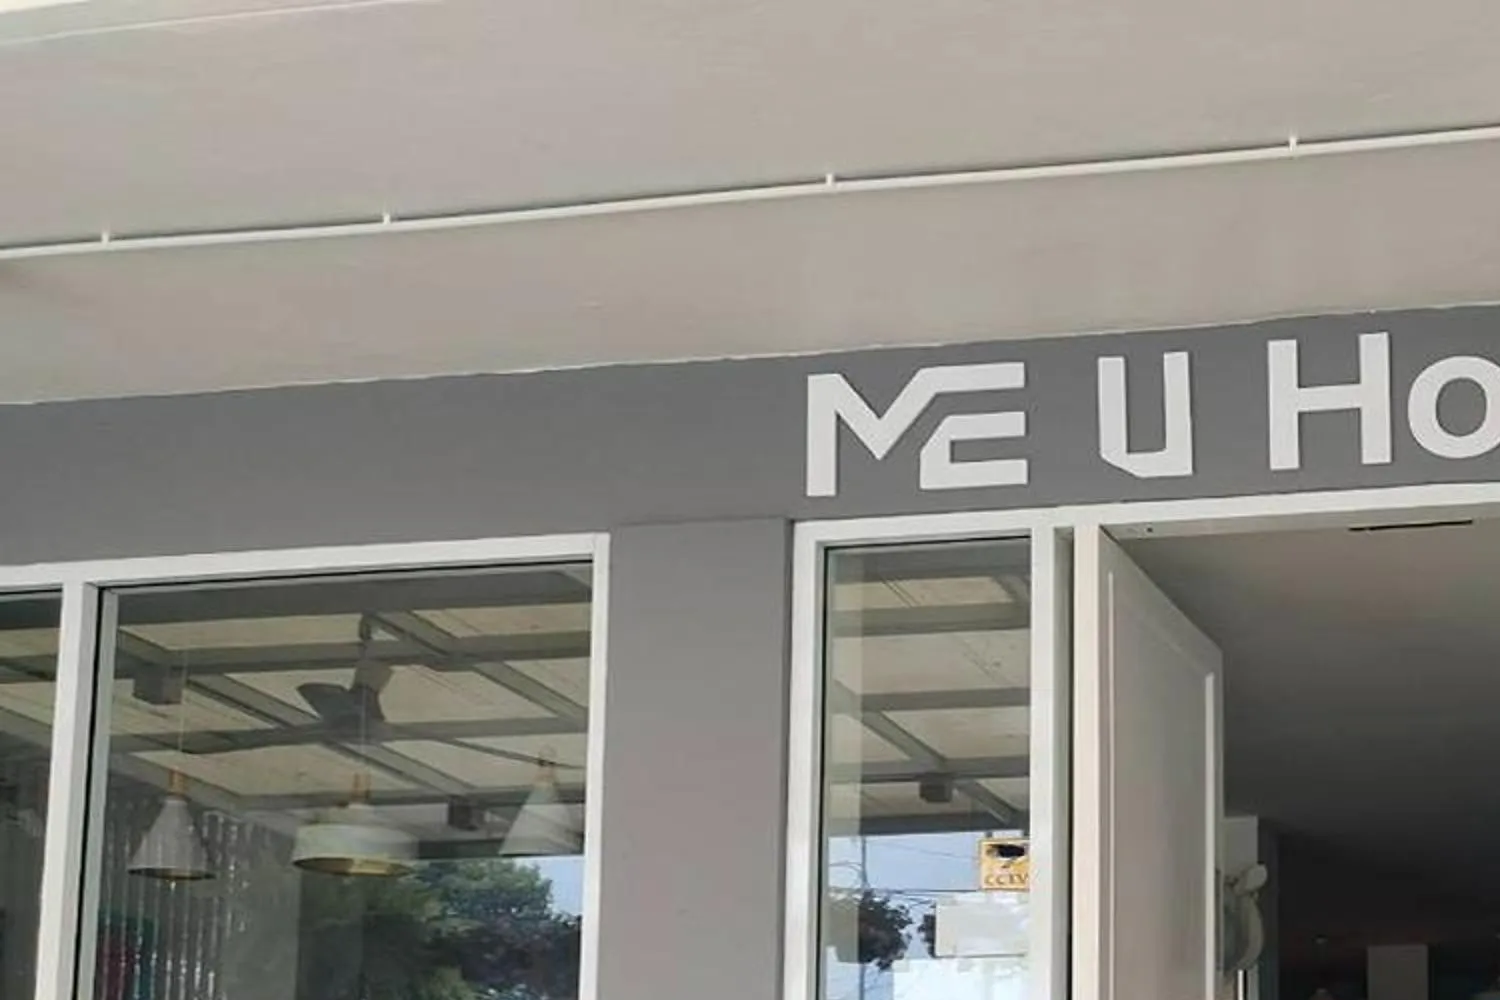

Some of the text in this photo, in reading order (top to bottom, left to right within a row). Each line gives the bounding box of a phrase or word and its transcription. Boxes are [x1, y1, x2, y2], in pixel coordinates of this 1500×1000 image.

[806, 362, 1029, 497] ME
[1098, 350, 1194, 478] U
[984, 872, 1029, 886] CCTV
